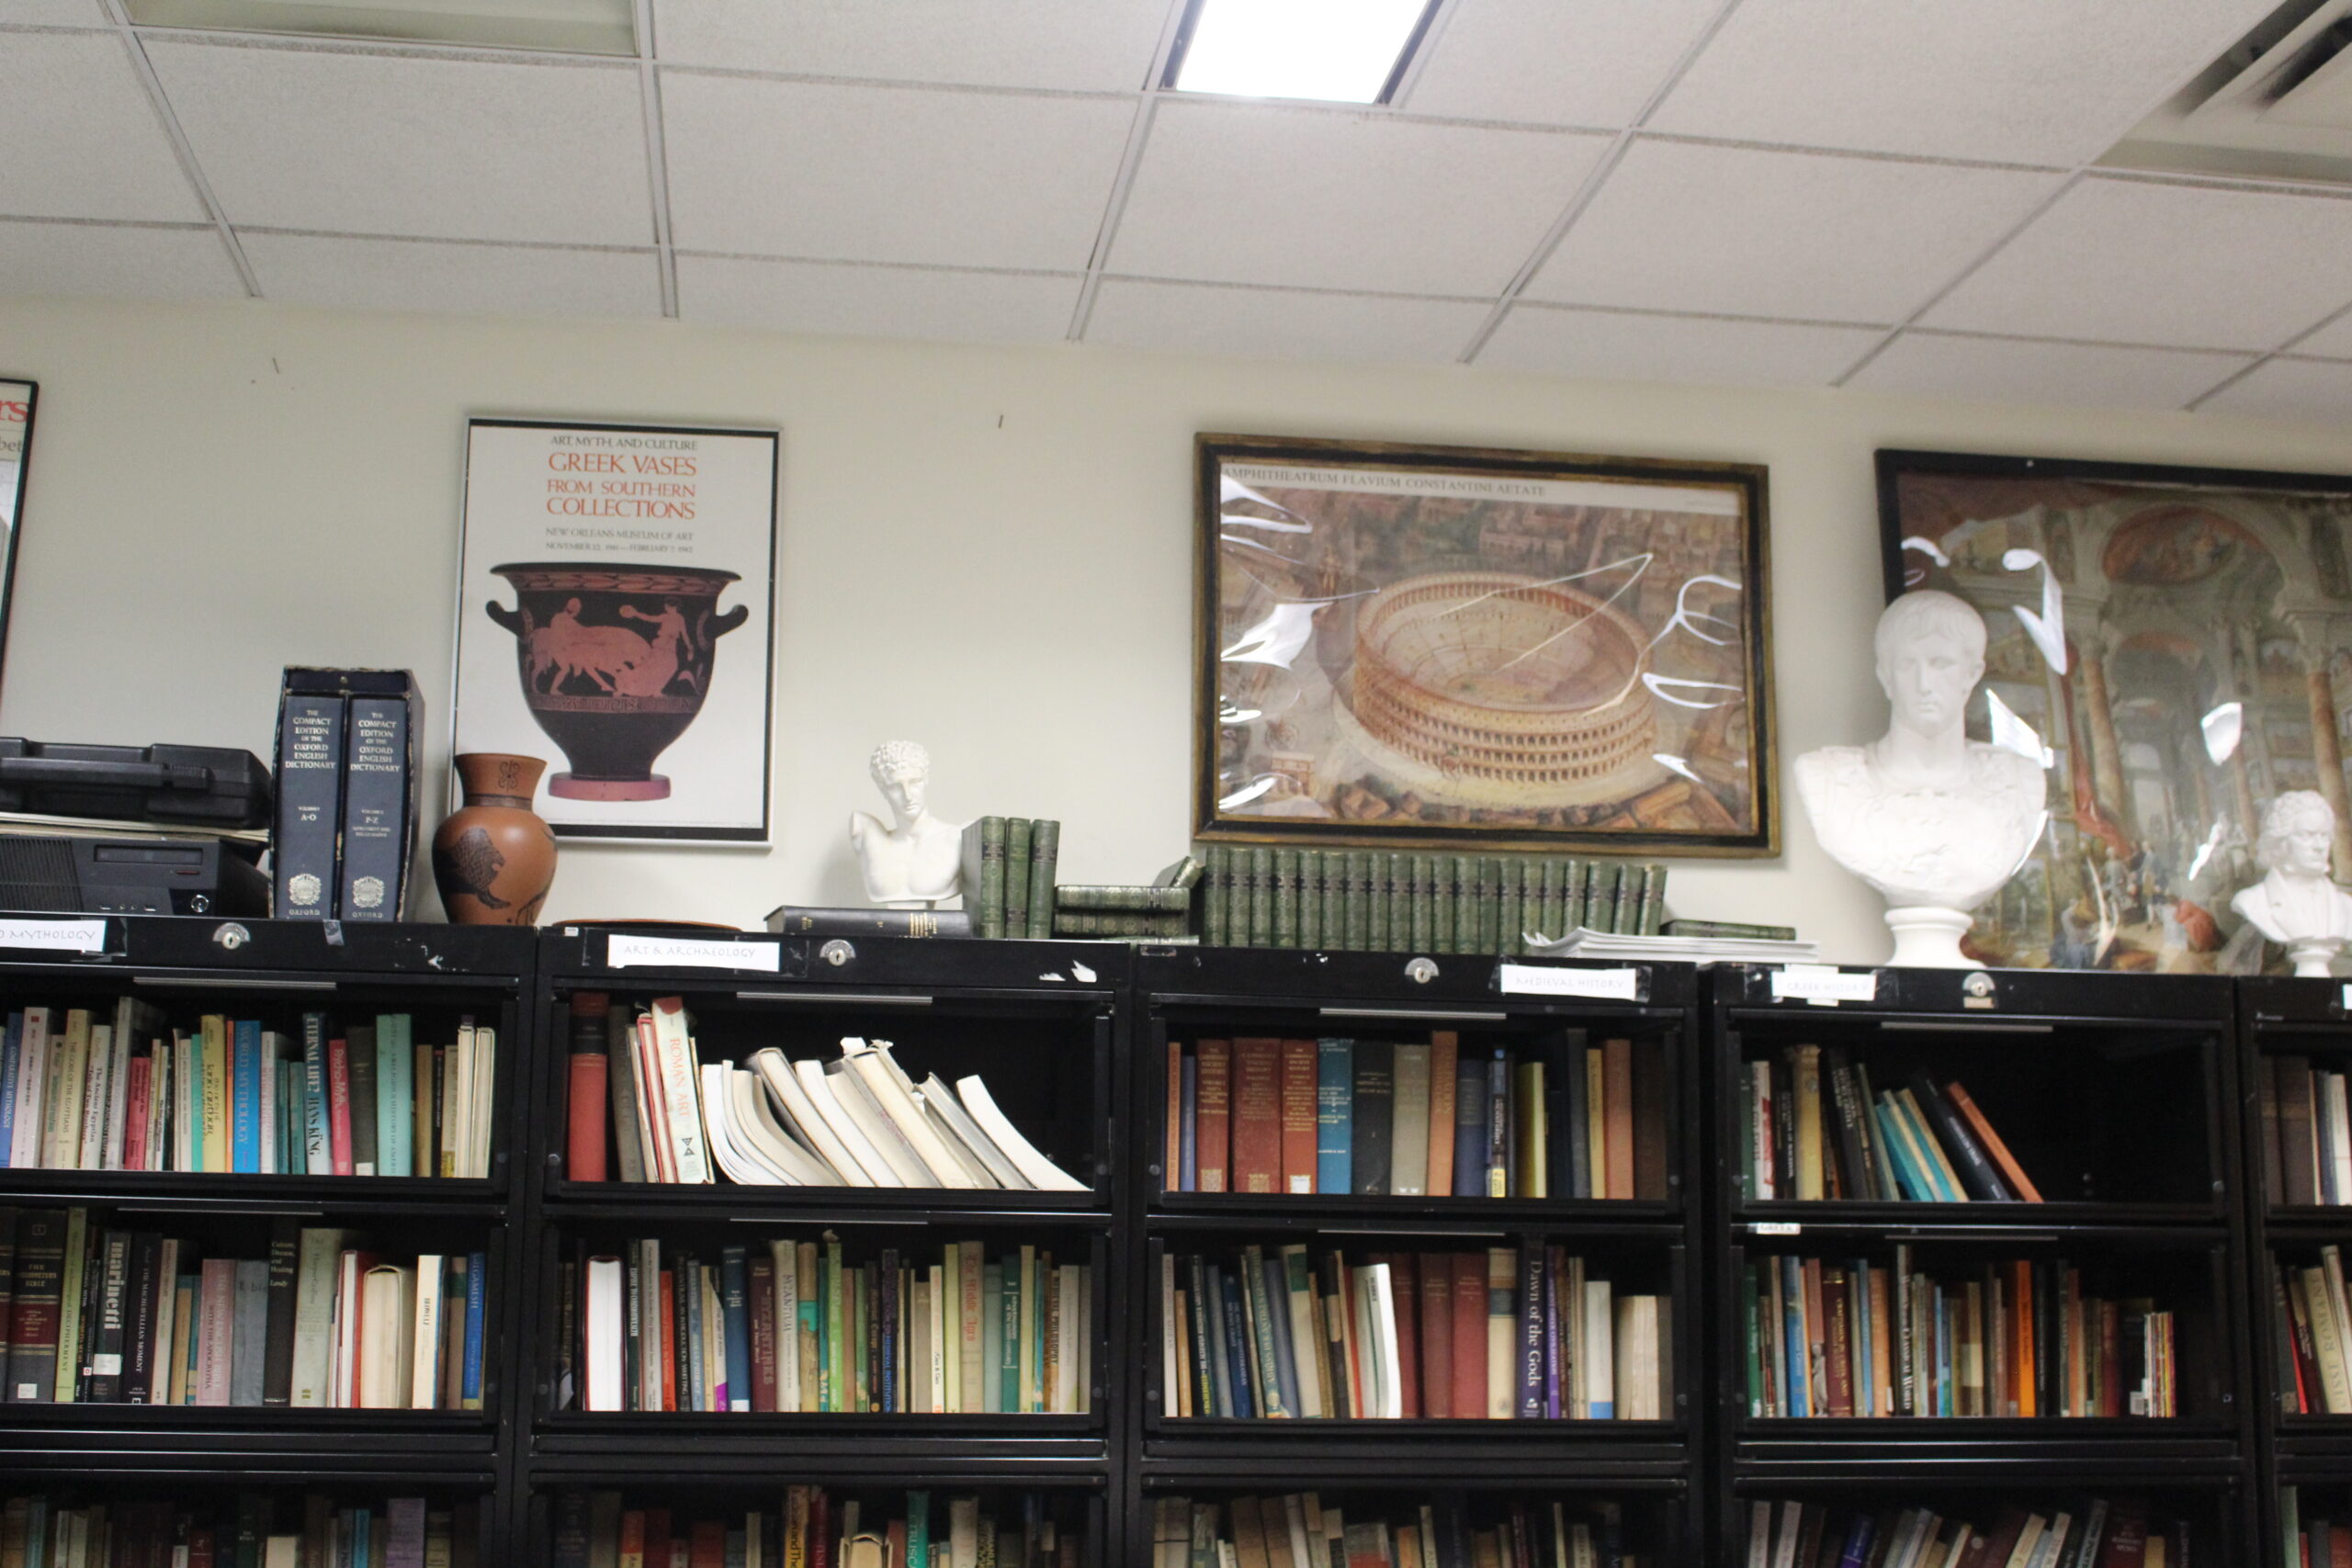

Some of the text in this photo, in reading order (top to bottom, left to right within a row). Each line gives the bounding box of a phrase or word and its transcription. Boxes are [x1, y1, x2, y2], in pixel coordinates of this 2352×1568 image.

[616, 438, 642, 448] AND
[645, 439, 698, 450] CULTURE
[548, 452, 697, 476] GREEK VASES
[548, 479, 695, 497] FROM SOUTHERN
[1224, 468, 1545, 496] AMPHITHEATRUM FLAVIUM CONSTANTINI AETATE
[547, 497, 695, 520] COLLECTIONS
[546, 528, 694, 541] NEW ORLEANS MUSEUM OF ART
[293, 717, 333, 726] COMPACT
[358, 720, 397, 728] COMPACT
[360, 729, 394, 738] EDITION
[359, 746, 393, 754] OXFORD
[285, 761, 335, 769] DICTIONARY
[350, 763, 401, 772] DICTIONARY
[10, 930, 96, 940] MYTHOLOGY
[625, 945, 756, 958] ART & ARCHAEOLOGY
[1516, 976, 1625, 988] MEDIEVAL HISTORY
[236, 1026, 250, 1145] WORLD MYTHOLOGY
[306, 1017, 323, 1156] ETERNAL LIFE? HANS KÜNG
[669, 1038, 691, 1118] ROMAN ART
[93, 1082, 101, 1109] Ancient
[3, 1090, 14, 1129] MYTHOLOGY
[104, 1242, 126, 1331] marinetti
[964, 1255, 978, 1341] The Middle Ages
[138, 1282, 149, 1339] MACHIAVELLIAN
[783, 1273, 795, 1332] BYZANTIUM
[1259, 1298, 1272, 1335] ANTIKEN
[1528, 1259, 1544, 1387] Dawn of the Gods
[1549, 1307, 1557, 1331] GREEK
[62, 1310, 73, 1372] DECIPHERMENT
[214, 1320, 226, 1361] ENGLISH
[761, 1295, 775, 1385] BYZANTINES
[1261, 1335, 1273, 1351] DER
[135, 1340, 145, 1373] MOMENT
[204, 1344, 213, 1389] APOCRYPHA
[1263, 1351, 1277, 1384] ABRISS
[213, 1363, 223, 1390] BIBLE
[1903, 1374, 1914, 1410] WORLD
